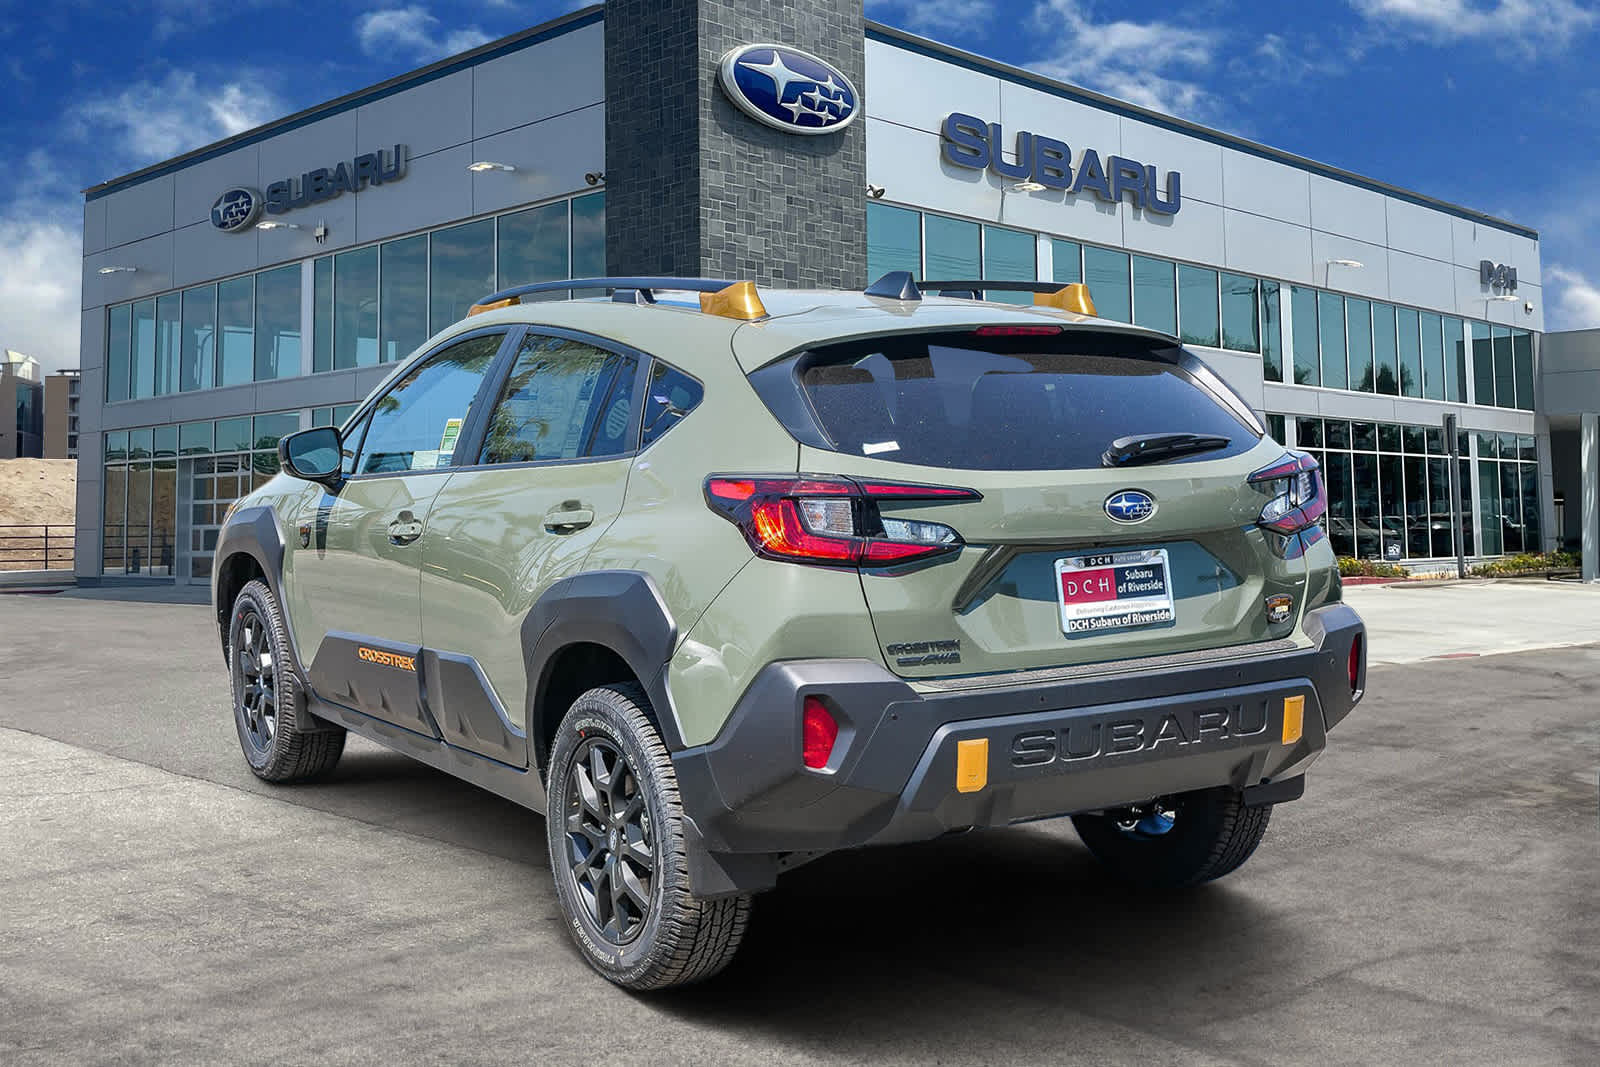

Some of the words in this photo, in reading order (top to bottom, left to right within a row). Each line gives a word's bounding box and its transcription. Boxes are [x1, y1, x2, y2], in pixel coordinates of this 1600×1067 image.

[941, 112, 1181, 215] SUBARU
[266, 143, 408, 215] SUBARU
[1125, 568, 1153, 580] Subaru
[1067, 577, 1110, 596] DCH
[1117, 582, 1127, 594] of
[1127, 579, 1164, 593] Riverside
[1070, 619, 1089, 630] DCH
[1090, 617, 1121, 628] Subaru
[1122, 614, 1132, 625] of
[1132, 610, 1170, 624] Riverside
[358, 647, 416, 671] CROSSTREK
[1010, 700, 1271, 768] SUBARU
